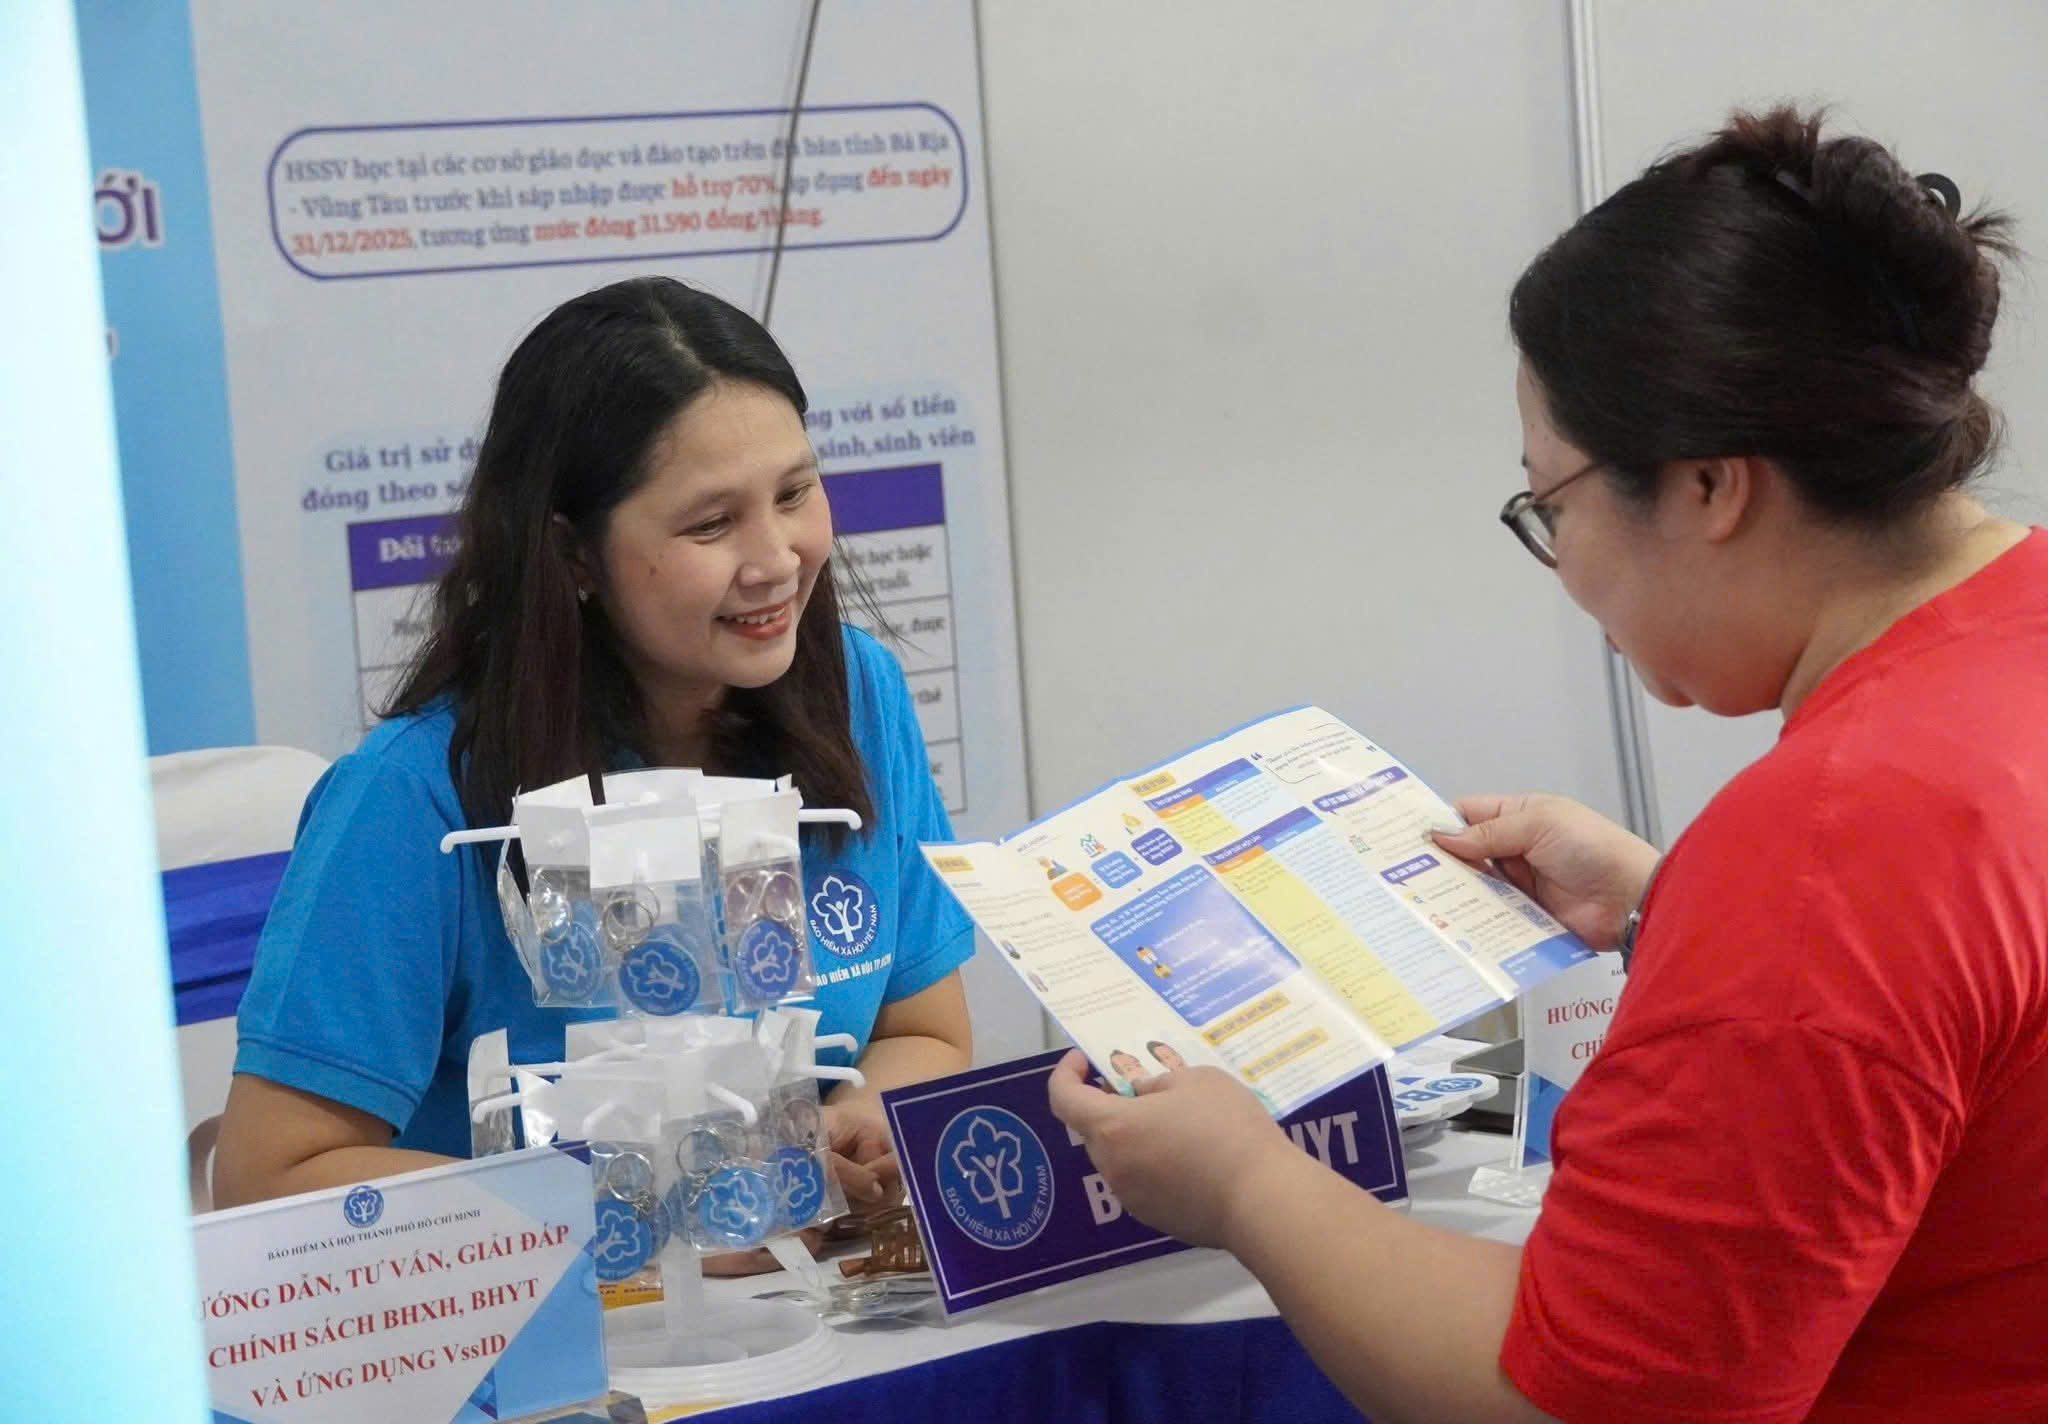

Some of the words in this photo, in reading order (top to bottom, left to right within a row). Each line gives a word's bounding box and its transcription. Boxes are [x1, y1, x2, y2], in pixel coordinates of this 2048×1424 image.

[285, 159, 347, 183] HSSV
[353, 156, 392, 182] học
[325, 446, 371, 473] Giá
[379, 442, 412, 470] trị
[806, 409, 833, 432] ng
[378, 478, 438, 505] theo
[1545, 996, 1614, 1025] HƯỚNG
[277, 1272, 341, 1306] DẪN,
[345, 1259, 385, 1289] TƯ
[390, 1248, 452, 1280] VẤN,
[457, 1233, 513, 1266] GIẢI
[520, 1221, 570, 1252] ĐÁP
[207, 1331, 298, 1369] CHÍNH
[304, 1313, 375, 1348] SÁCH
[384, 1296, 465, 1330] BHXH,
[471, 1277, 539, 1312] BHYT
[251, 1378, 290, 1409] VÀ
[295, 1366, 354, 1399] ỨNG
[361, 1350, 436, 1384] DỤNG
[443, 1333, 508, 1365] VssID
